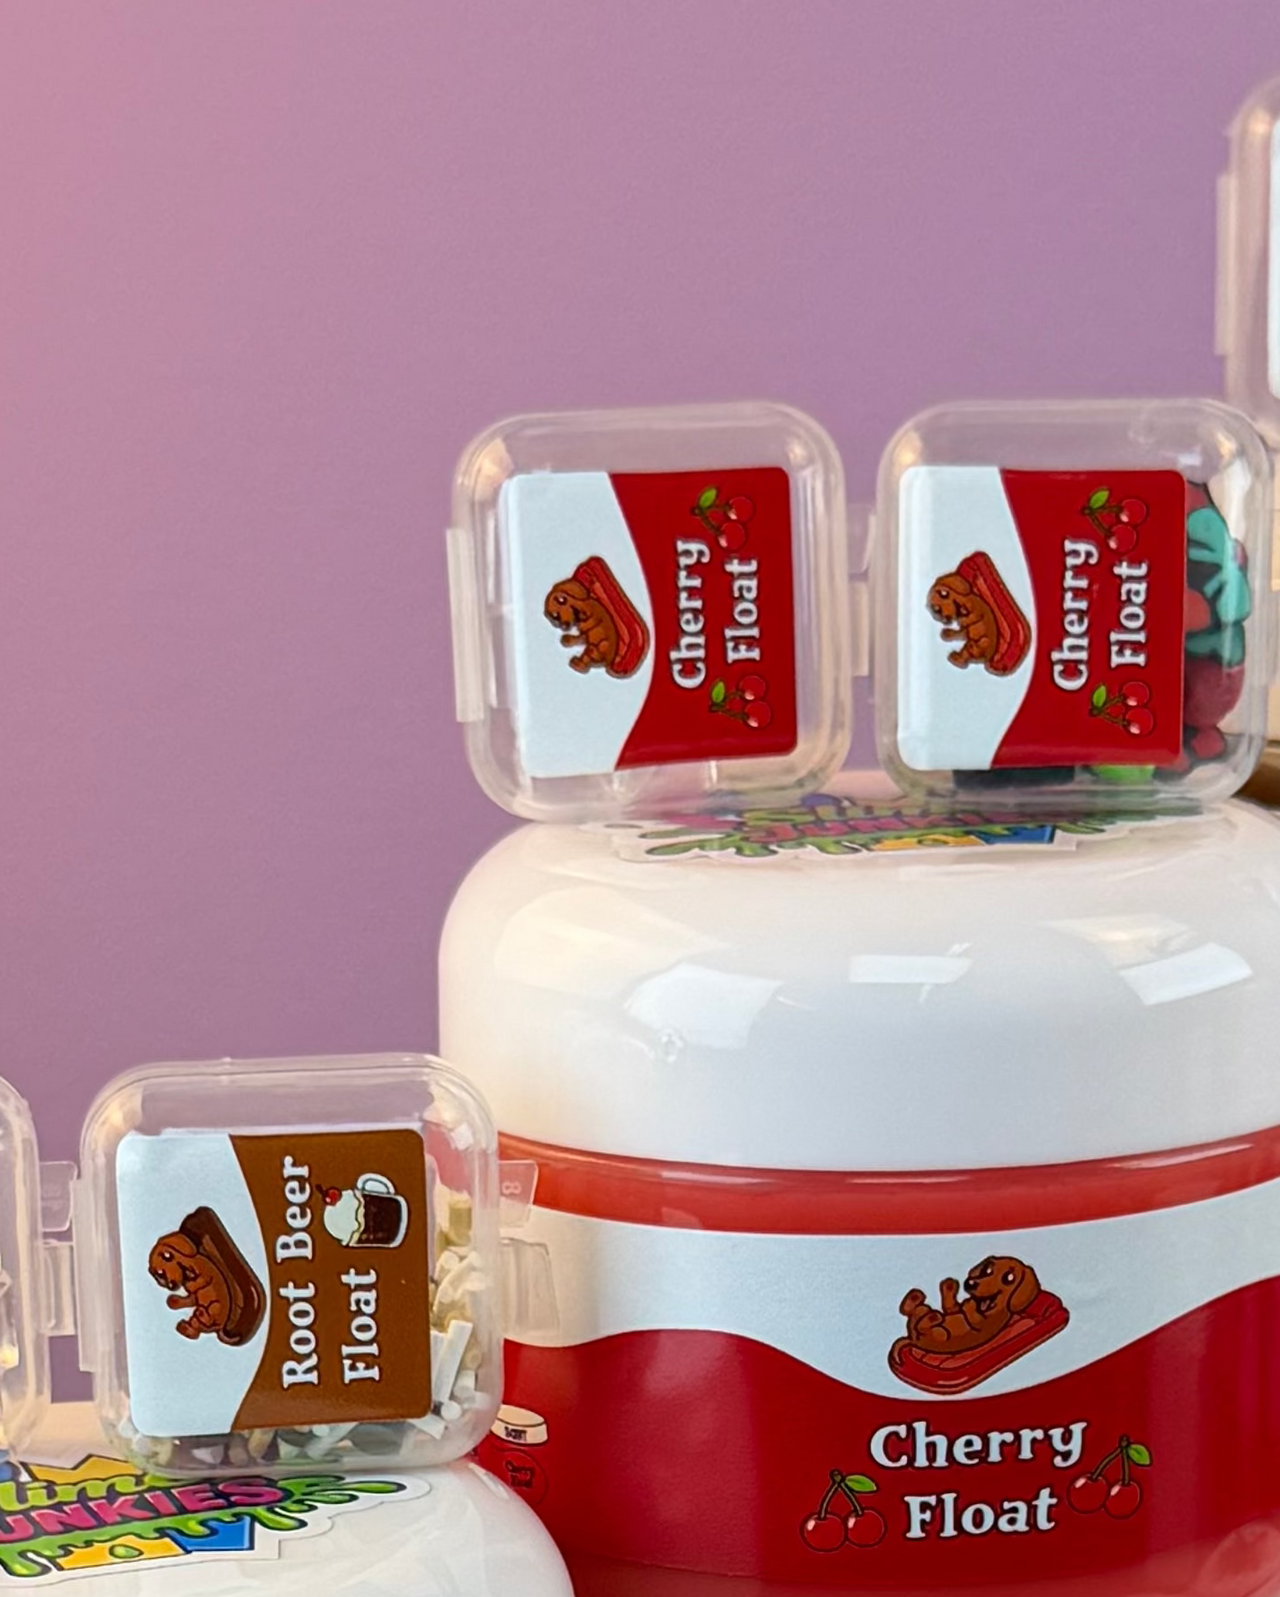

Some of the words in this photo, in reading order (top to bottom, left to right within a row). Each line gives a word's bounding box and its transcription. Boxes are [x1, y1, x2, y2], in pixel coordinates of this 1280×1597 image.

[671, 537, 711, 690] Cherry
[723, 557, 761, 664] Float
[1052, 537, 1100, 692] Cherry
[1109, 559, 1148, 669] Float
[277, 1155, 317, 1266] Beer
[280, 1281, 320, 1389] Root
[342, 1267, 381, 1383] Float
[869, 1420, 1088, 1469] Cherry
[903, 1486, 1058, 1540] Float
